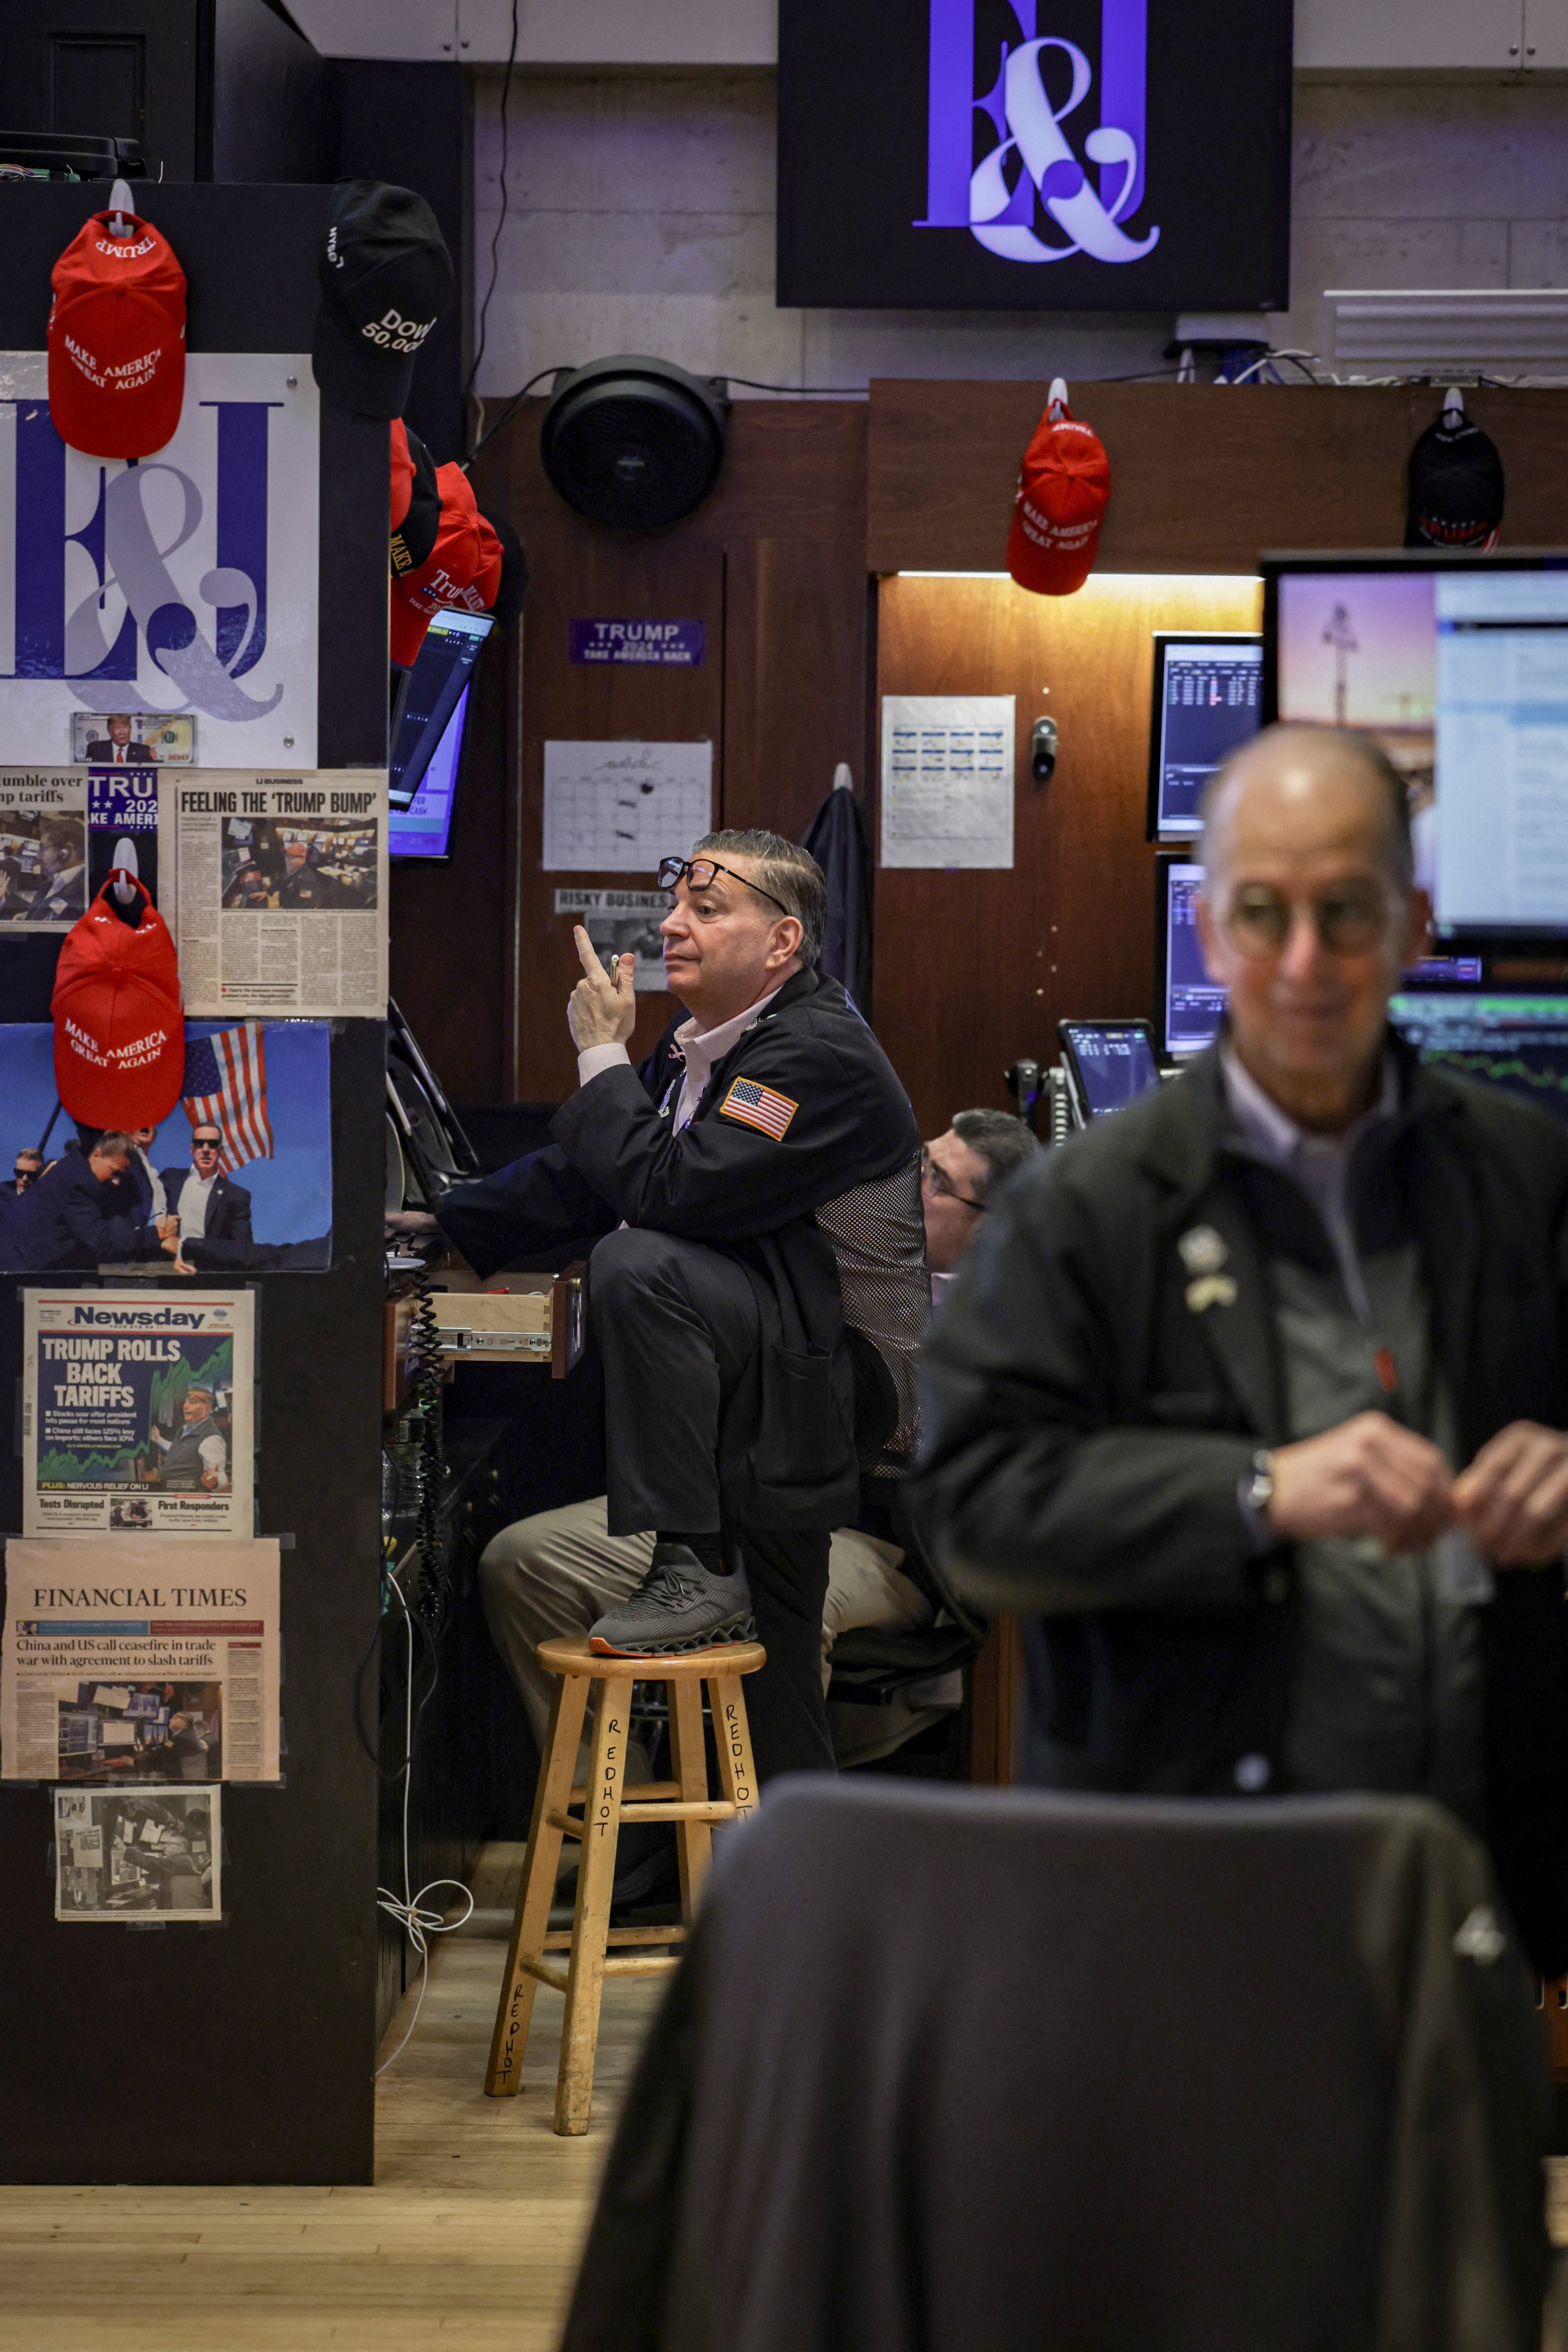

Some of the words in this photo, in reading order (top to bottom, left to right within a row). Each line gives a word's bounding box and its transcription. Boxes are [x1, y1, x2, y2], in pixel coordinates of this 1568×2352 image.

[95, 235, 157, 258] TRUMP
[380, 308, 437, 340] DOW
[65, 334, 96, 370] MAKE
[115, 364, 156, 390] AGAIN
[391, 534, 412, 570] MAKE
[429, 569, 464, 599] Tru
[595, 623, 680, 641] TRUMP
[51, 777, 83, 787] over
[88, 776, 153, 798] TRU
[19, 789, 64, 802] tariffs
[125, 799, 157, 812] 202
[181, 792, 236, 812] FEELING
[242, 792, 267, 812] THE
[88, 812, 108, 824] KE
[560, 891, 601, 906] RISKY
[65, 1018, 99, 1052] MAKE
[106, 1030, 167, 1058] AMERICA
[71, 1039, 110, 1067] GREAT
[118, 1047, 161, 1069] AGAIN
[74, 1306, 205, 1329] Newsday
[42, 1338, 114, 1360] TRUMP
[117, 1340, 181, 1362] ROLLS
[67, 1363, 122, 1384] BACK
[54, 1385, 135, 1407] TARIFFS
[39, 1499, 61, 1508] Tests
[64, 1499, 104, 1510] Disrupted
[158, 1501, 177, 1510] First
[180, 1501, 229, 1511] Responders
[34, 1588, 165, 1607] FINANCIAL
[171, 1588, 247, 1607] TIMES
[16, 1639, 51, 1650] China
[53, 1639, 75, 1650] and
[78, 1640, 95, 1650] US
[97, 1639, 116, 1650] call
[119, 1639, 169, 1650] ceasefire
[172, 1639, 183, 1650] in
[186, 1639, 216, 1650] trade
[16, 1657, 39, 1666] war
[41, 1654, 67, 1666] with
[69, 1656, 131, 1668] agreement
[134, 1656, 145, 1666] to
[148, 1654, 176, 1666] slash
[179, 1654, 213, 1666] tariffs
